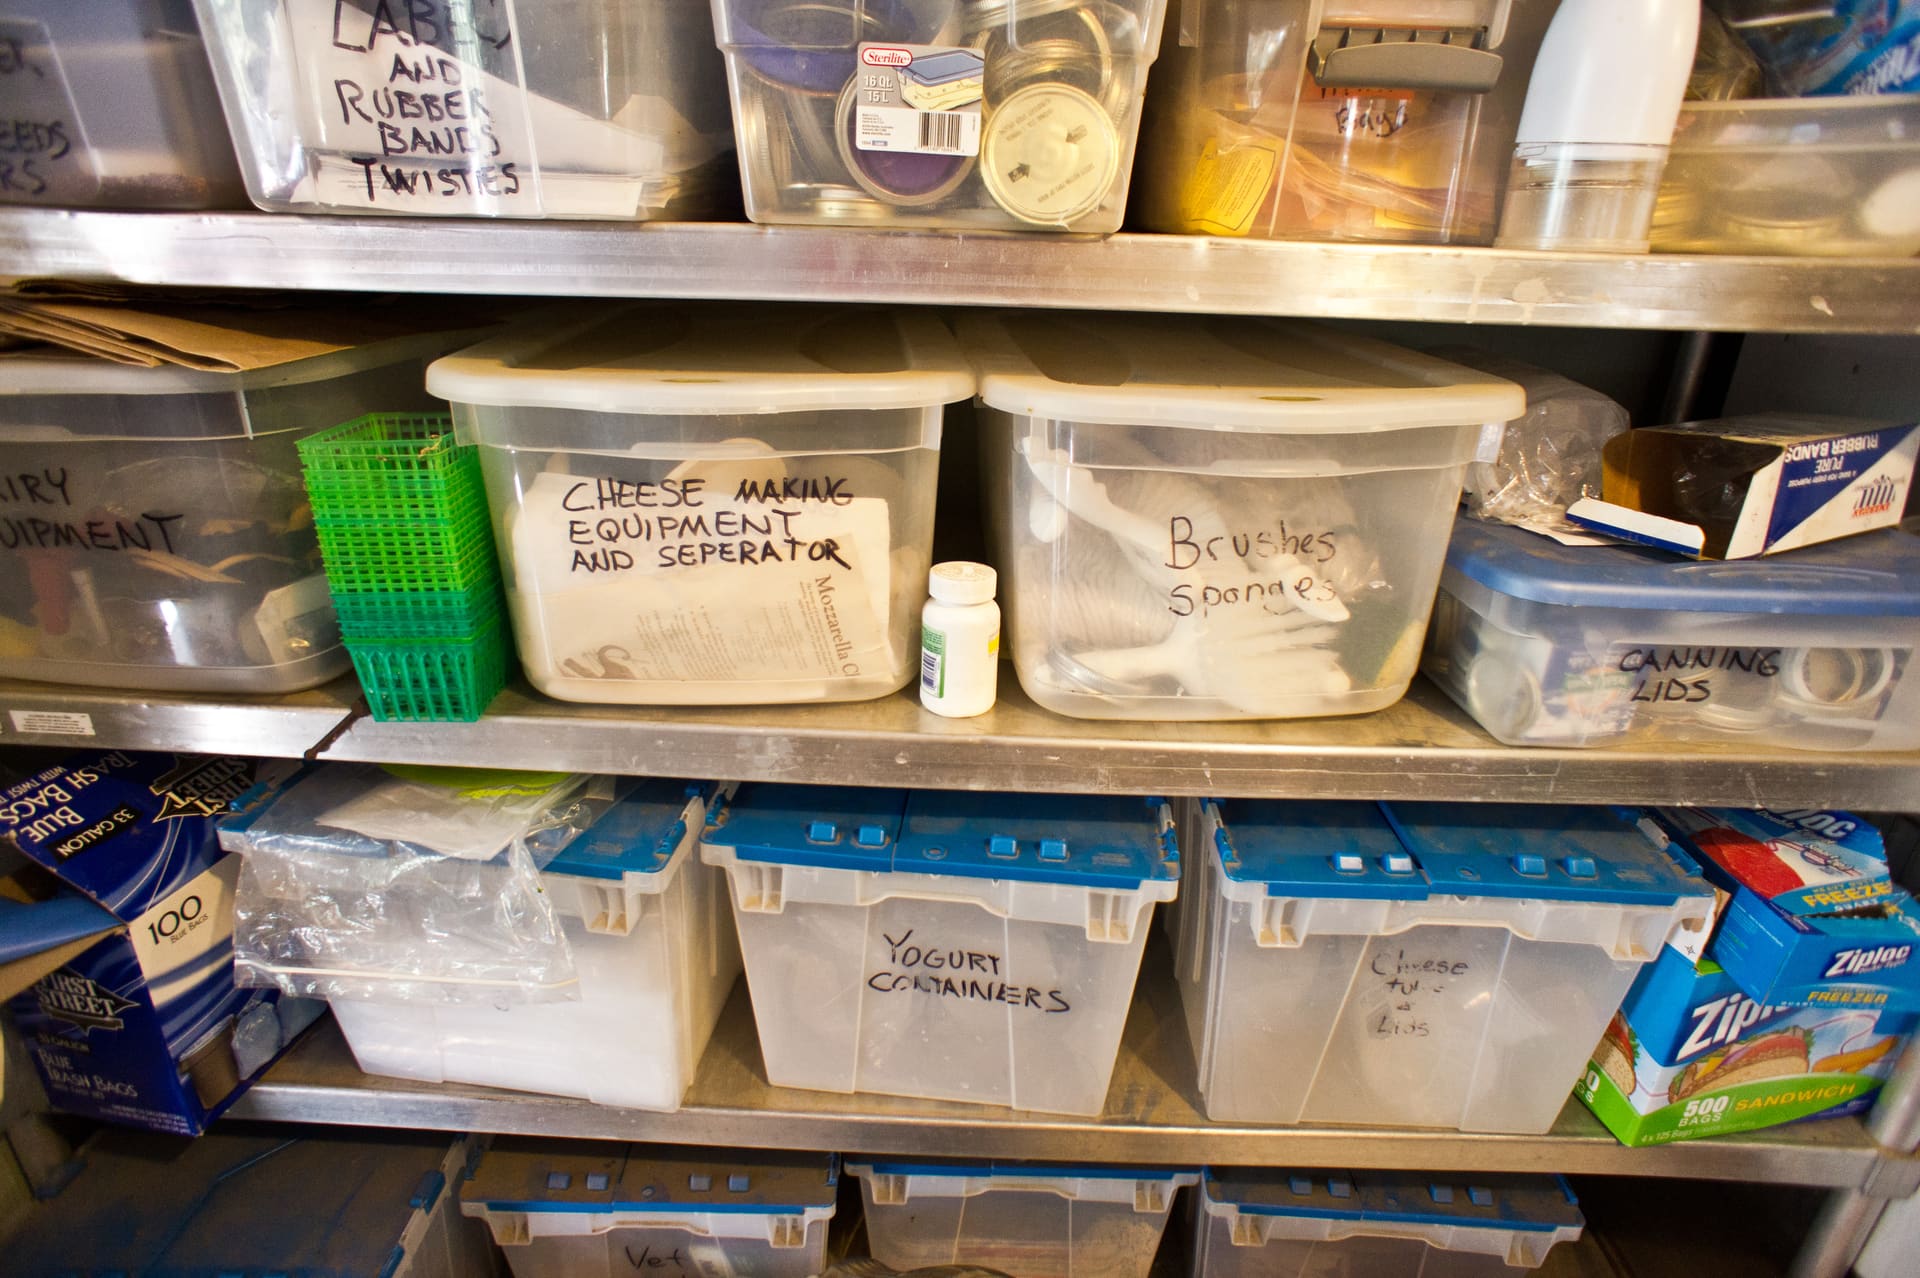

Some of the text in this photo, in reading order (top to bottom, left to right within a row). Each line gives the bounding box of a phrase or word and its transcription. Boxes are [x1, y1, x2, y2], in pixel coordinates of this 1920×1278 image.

[389, 53, 462, 86] AND
[867, 51, 907, 64] Sterilite
[863, 75, 877, 88] 16
[868, 91, 889, 103] 15 L
[334, 79, 492, 125] RUBBER
[378, 121, 501, 156] BANDS
[1784, 434, 1879, 463] RUBBER BANDS
[1814, 456, 1844, 474] PURE
[0, 467, 71, 506] IRY
[562, 476, 855, 512] CHEESE MAKING
[569, 509, 803, 546] EQUIPMENT
[1164, 516, 1337, 570] Brushes
[571, 537, 853, 574] AND SEPERATOR
[815, 573, 853, 661] Mozzarella
[1618, 647, 1781, 677] CANNING
[1630, 678, 1712, 703] LIDS
[0, 751, 140, 825] TRASH BAGS
[7, 766, 67, 797] WITH TWIST
[166, 757, 249, 809] STREET
[193, 773, 249, 817] FIRST
[20, 805, 85, 844] BLUE
[57, 808, 135, 857] 33 GALLON
[147, 895, 202, 945] 100
[883, 929, 1000, 976] YOGURT
[1824, 945, 1911, 978] Ziploc
[868, 971, 1071, 1013] CONTAINERS
[1807, 990, 1889, 1005] FREEZER
[1676, 993, 1789, 1062] Zip
[93, 1074, 138, 1098] BAGS
[1683, 1095, 1729, 1118] 500
[1734, 1083, 1856, 1113] SANDWICH
[1678, 1112, 1722, 1128] BAGS
